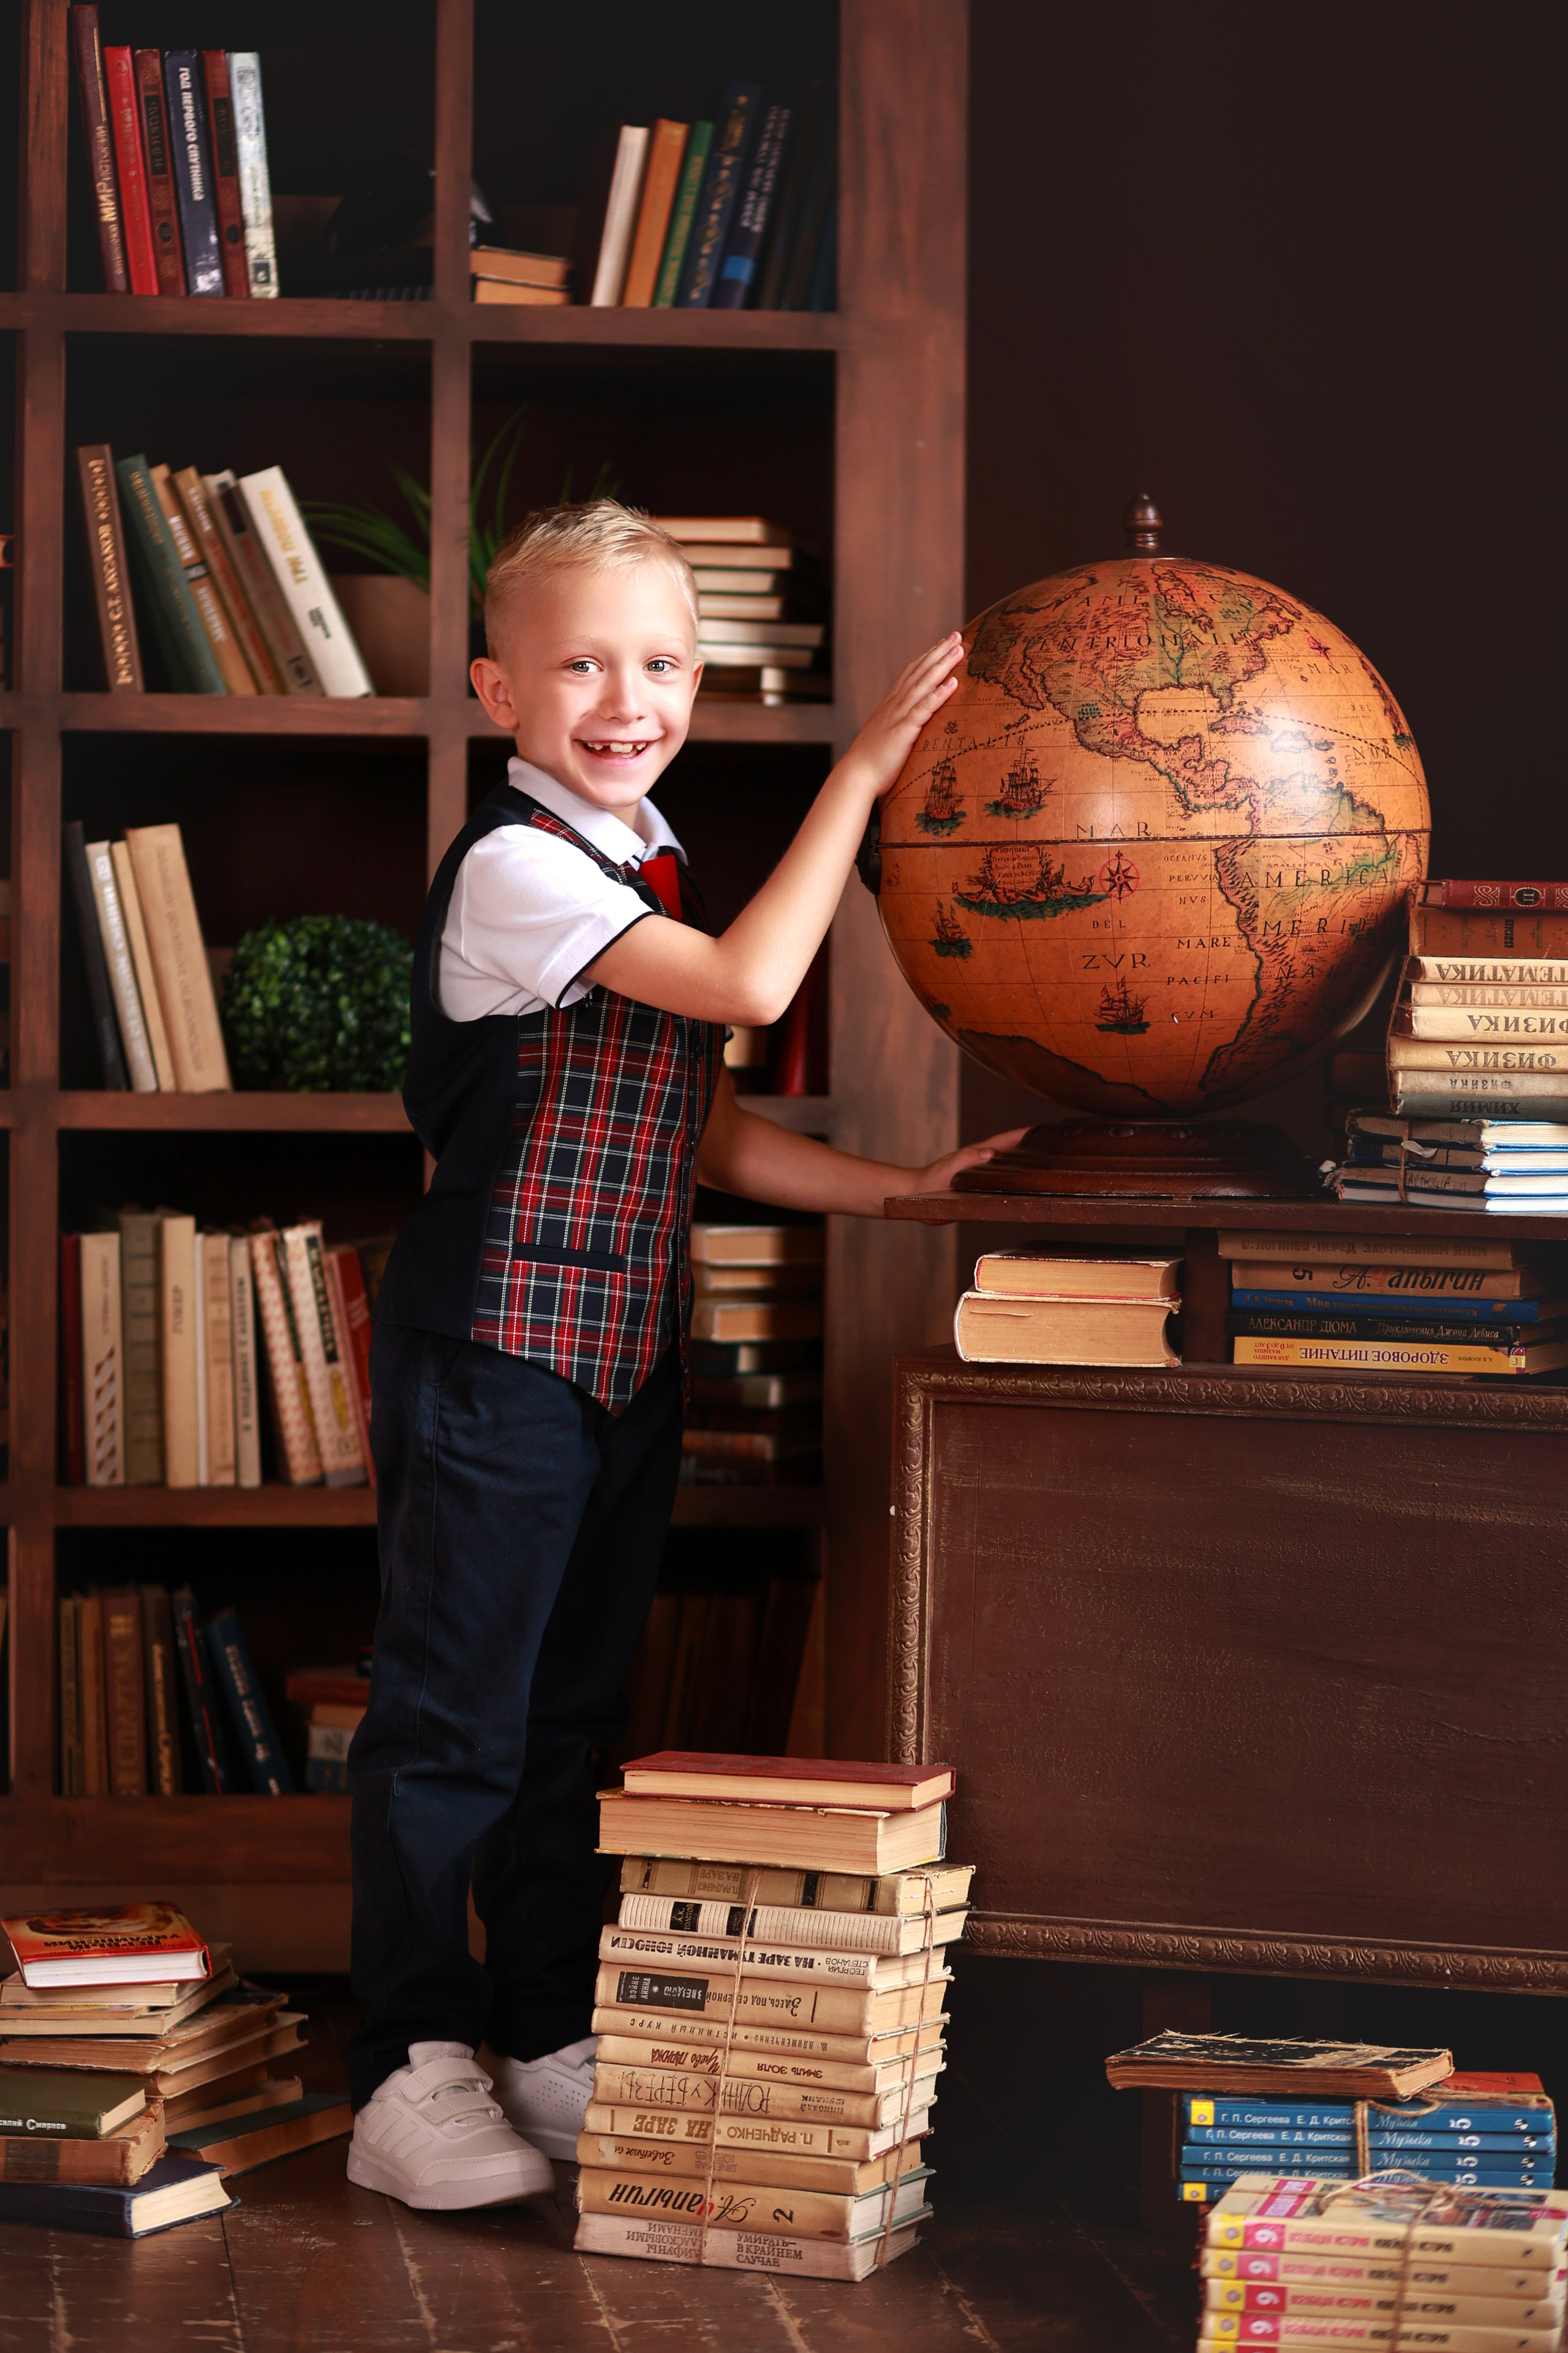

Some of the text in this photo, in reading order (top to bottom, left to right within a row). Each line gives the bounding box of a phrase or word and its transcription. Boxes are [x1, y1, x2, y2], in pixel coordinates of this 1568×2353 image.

[179, 67, 204, 202] ГОД ПЕРВОГО СПУТНИКА
[1307, 663, 1353, 674] MAR
[924, 736, 1025, 750] DENTALIS
[1076, 821, 1152, 839] MAR
[1238, 869, 1389, 888] AMERICA
[1092, 920, 1126, 929] DEL
[1177, 937, 1231, 949] MARE
[1082, 953, 1150, 969] ZVR
[1167, 975, 1229, 985] PACIFI
[1435, 963, 1568, 983] ТЕМАТИКА
[1435, 987, 1568, 1007] ТЕМАТИКА
[1446, 1051, 1556, 1070] ФИЗИКА
[1450, 1079, 1511, 1089] ФИЗИКА
[1449, 1100, 1520, 1115] ХИМИЯ
[1292, 1267, 1313, 1281] 5
[1263, 1296, 1294, 1306] Тарасов
[1306, 1296, 1330, 1309] Мир
[1415, 1306, 1478, 1316] вероятности
[1248, 1317, 1499, 1339] АЛЕКСАНДР ДЮМА Приключения Джона Девиса
[1299, 1347, 1368, 1361] ПИТАНИЕ
[1372, 1350, 1450, 1365] ЗДОРОВОЕ
[699, 1868, 741, 1883] НА ЗАРЕ
[611, 1936, 673, 1954] ЮНОСТИ
[758, 1952, 791, 1966] ЗАРЕ
[795, 1956, 815, 1970] НА
[825, 1957, 869, 1968] СТЕПАНОВ
[828, 1966, 865, 1976] ГЕОРГИЙ
[664, 1985, 703, 2000] ЗВЕЗДОЮ
[706, 1991, 748, 2004] СЕЕРНОЙ
[752, 1995, 766, 2007] ПОД
[630, 2019, 662, 2030] КУРС
[671, 2024, 737, 2040] ИСТИННЫЙ
[754, 2034, 813, 2050] КЛИМЕНЧЕНКО
[650, 2048, 689, 2067] ПАРИЖА
[756, 2063, 788, 2075] ЗОЛЯ
[791, 2067, 823, 2079] ЭМИЛЬ
[618, 2071, 689, 2106] БЕРЕЗЫ
[0, 2118, 67, 2131] силий Смирнов
[633, 2114, 677, 2135] ЗАРЕ
[1221, 2113, 1227, 2122] Г.
[1232, 2114, 1240, 2123] П.
[1245, 2115, 1291, 2124] Сергеева
[1297, 2115, 1306, 2124] Е.
[1309, 2116, 1320, 2126] Д.
[1323, 2116, 1355, 2126] Критс
[1449, 2117, 1472, 2129] 5
[685, 2120, 713, 2139] НА
[726, 2126, 796, 2144] РАДЧЕНКО
[799, 2132, 813, 2145] П.
[1206, 2129, 1213, 2139] Г.
[1216, 2130, 1226, 2139] П.
[1229, 2131, 1275, 2140] Сергеева
[1294, 2132, 1305, 2142] Д.
[1308, 2132, 1352, 2142] Критская
[1379, 2132, 1433, 2148] Музыка
[1458, 2134, 1481, 2147] 5
[625, 2148, 675, 2166] Заветное
[1204, 2151, 1479, 2168] Г. П. Сергеева Е. Д. Критская Музыка 5
[1455, 2174, 1477, 2185] 5
[772, 2207, 794, 2224] 2
[626, 2230, 698, 2247] ЛАСКОВЫМИ
[1254, 2228, 1278, 2243] 9
[646, 2243, 703, 2260] АЙФУНЫ
[737, 2243, 803, 2260] В КРАЙНЕМ
[736, 2254, 780, 2267] СЛУЧАЕ
[1248, 2259, 1272, 2275] 9
[1256, 2291, 1280, 2306] 9
[1249, 2320, 1273, 2335] 9
